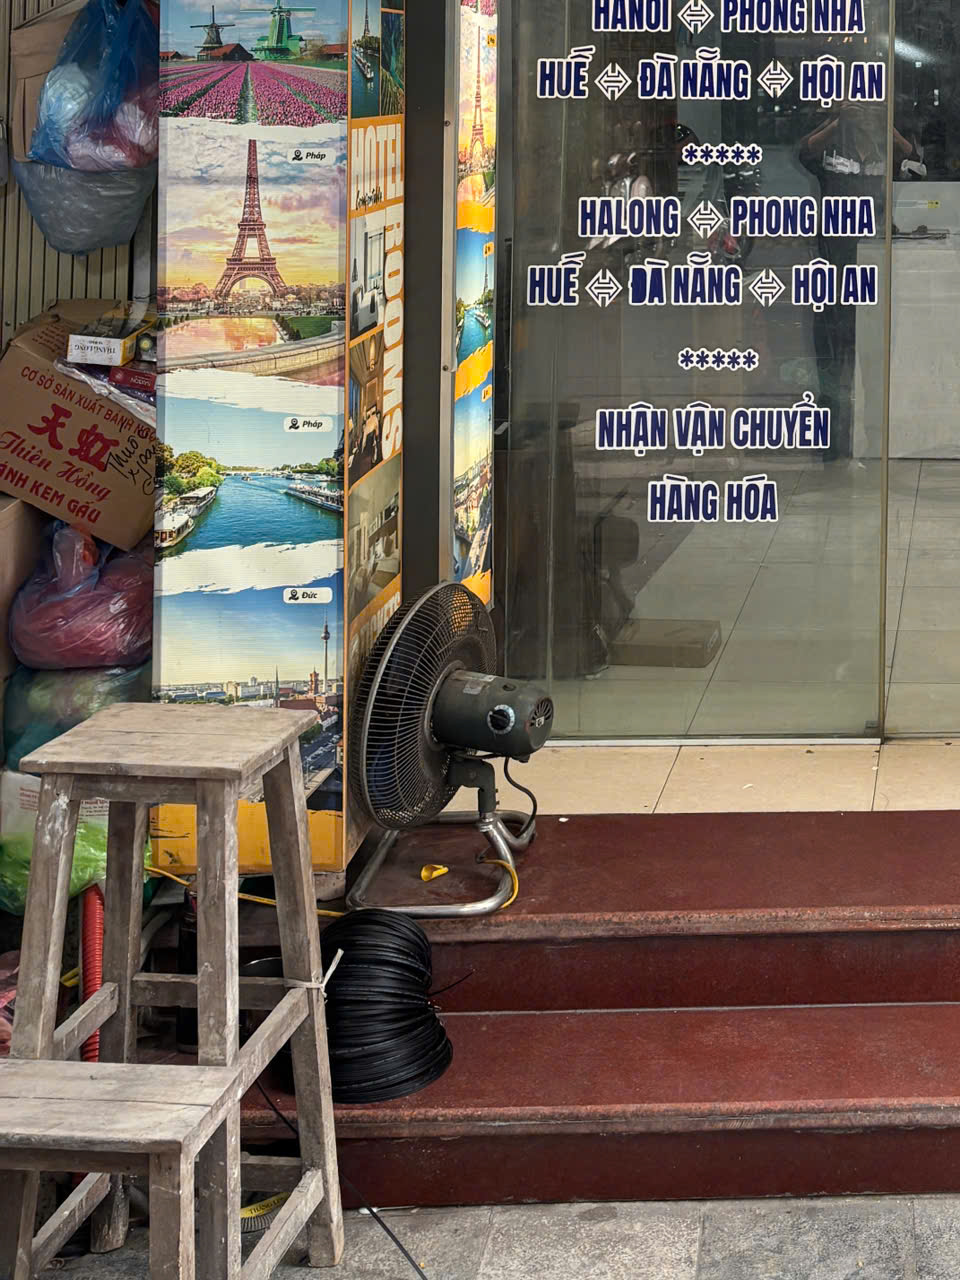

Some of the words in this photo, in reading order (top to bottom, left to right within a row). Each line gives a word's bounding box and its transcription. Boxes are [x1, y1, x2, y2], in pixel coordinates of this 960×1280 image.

[536, 45, 596, 100] HUẾ
[637, 52, 679, 100] ĐÀ
[680, 46, 752, 100] NẴNG
[800, 54, 845, 108] HỘI
[848, 61, 886, 102] AN
[305, 151, 326, 162] Pháp
[352, 123, 404, 210] HOTEL
[578, 196, 681, 238] HALONG
[730, 196, 818, 237] PHONG
[821, 197, 876, 237] NHA
[527, 251, 587, 306] HUẾ
[628, 258, 669, 306] ĐÀ
[671, 251, 743, 306] NẴNG
[791, 257, 837, 312] HỘI
[840, 265, 878, 305] AN
[382, 203, 405, 461] ROOMS
[21, 366, 39, 382] CƠ
[37, 368, 55, 391] SỞ
[53, 381, 75, 404] SẢN
[75, 390, 104, 418] XUẤT
[103, 406, 135, 431] BÁNH
[302, 419, 323, 430] Pháp
[595, 401, 668, 456] NHẬN
[672, 400, 726, 456] VẬN
[730, 390, 831, 449] CHUYỂN
[0, 430, 53, 472] Thiên
[56, 460, 112, 502] Hồng
[27, 403, 120, 472] 天虹
[0, 462, 28, 490] ÁNH
[29, 479, 66, 507] KEM
[67, 498, 102, 524] GẤU
[647, 473, 719, 523] HÀNG
[724, 473, 779, 523] HÓA
[301, 589, 319, 601] Đức
